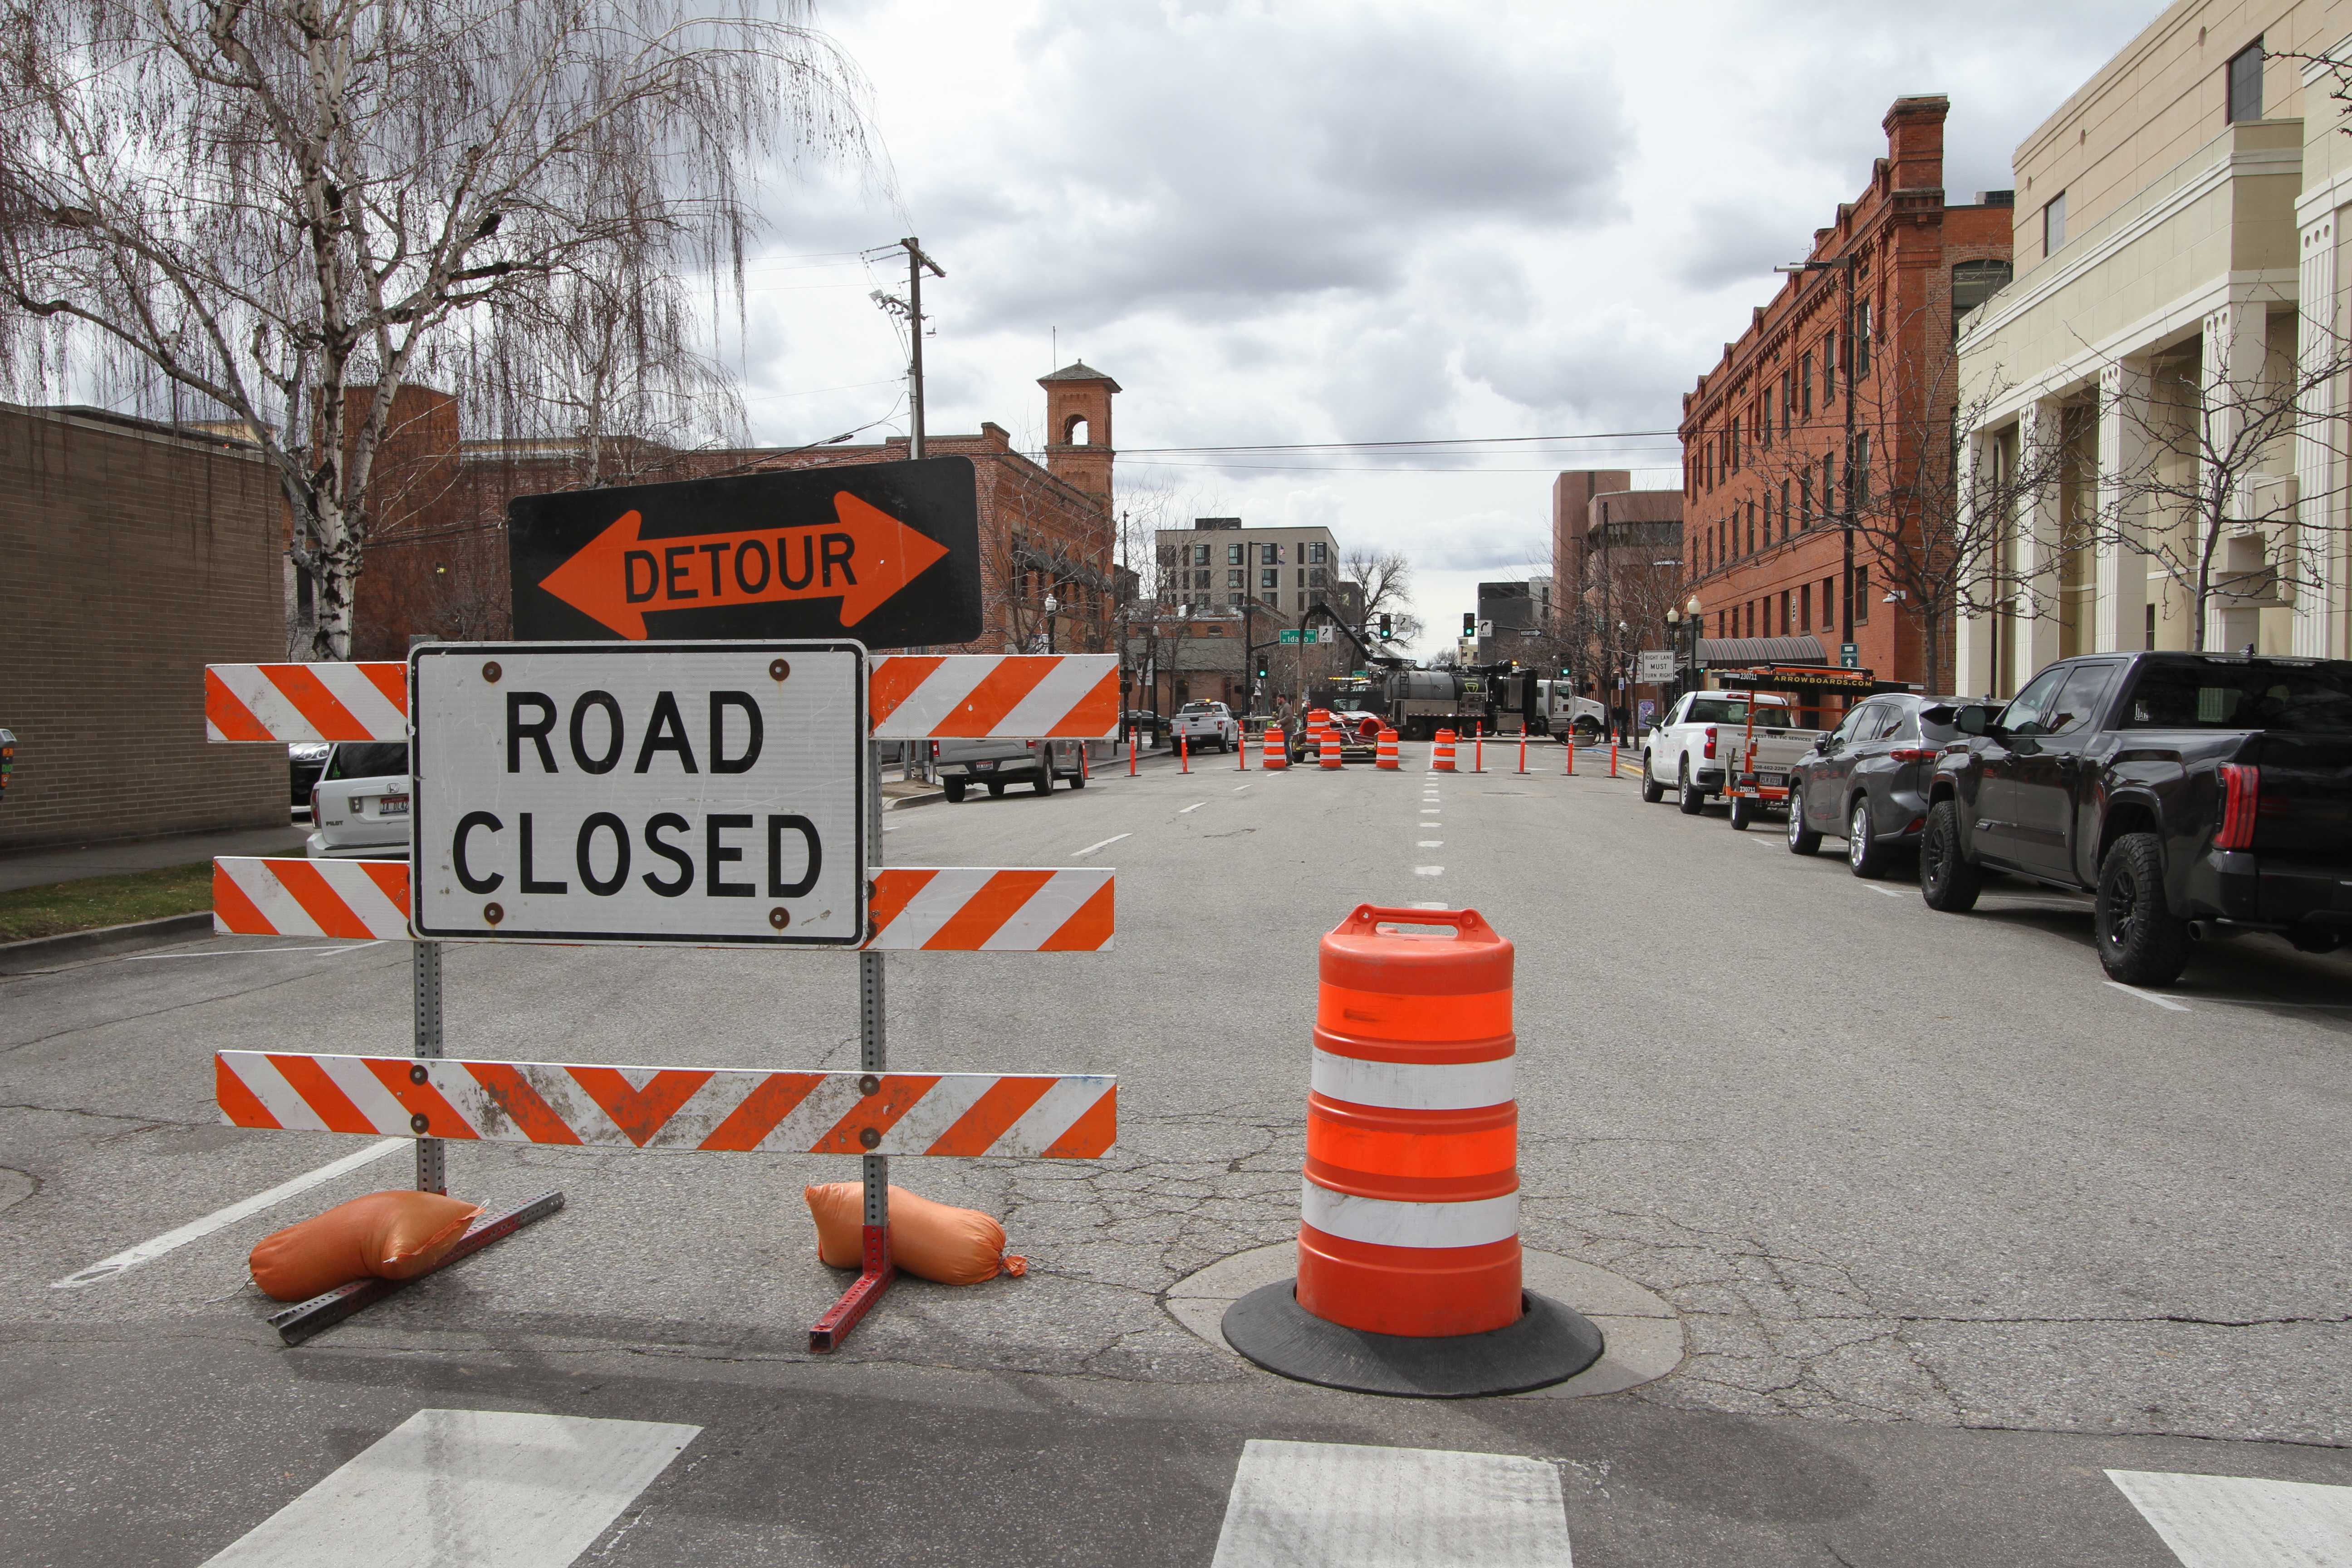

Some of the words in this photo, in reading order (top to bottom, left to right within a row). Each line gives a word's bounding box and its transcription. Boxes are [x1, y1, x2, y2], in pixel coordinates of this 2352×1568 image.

[624, 532, 858, 603] DETOUR
[1774, 676, 1872, 686] ARROWBOARDS.COM
[506, 690, 764, 774] ROAD
[382, 803, 389, 811] 1A
[393, 802, 409, 810] DL42
[453, 811, 822, 898] CLOSED
